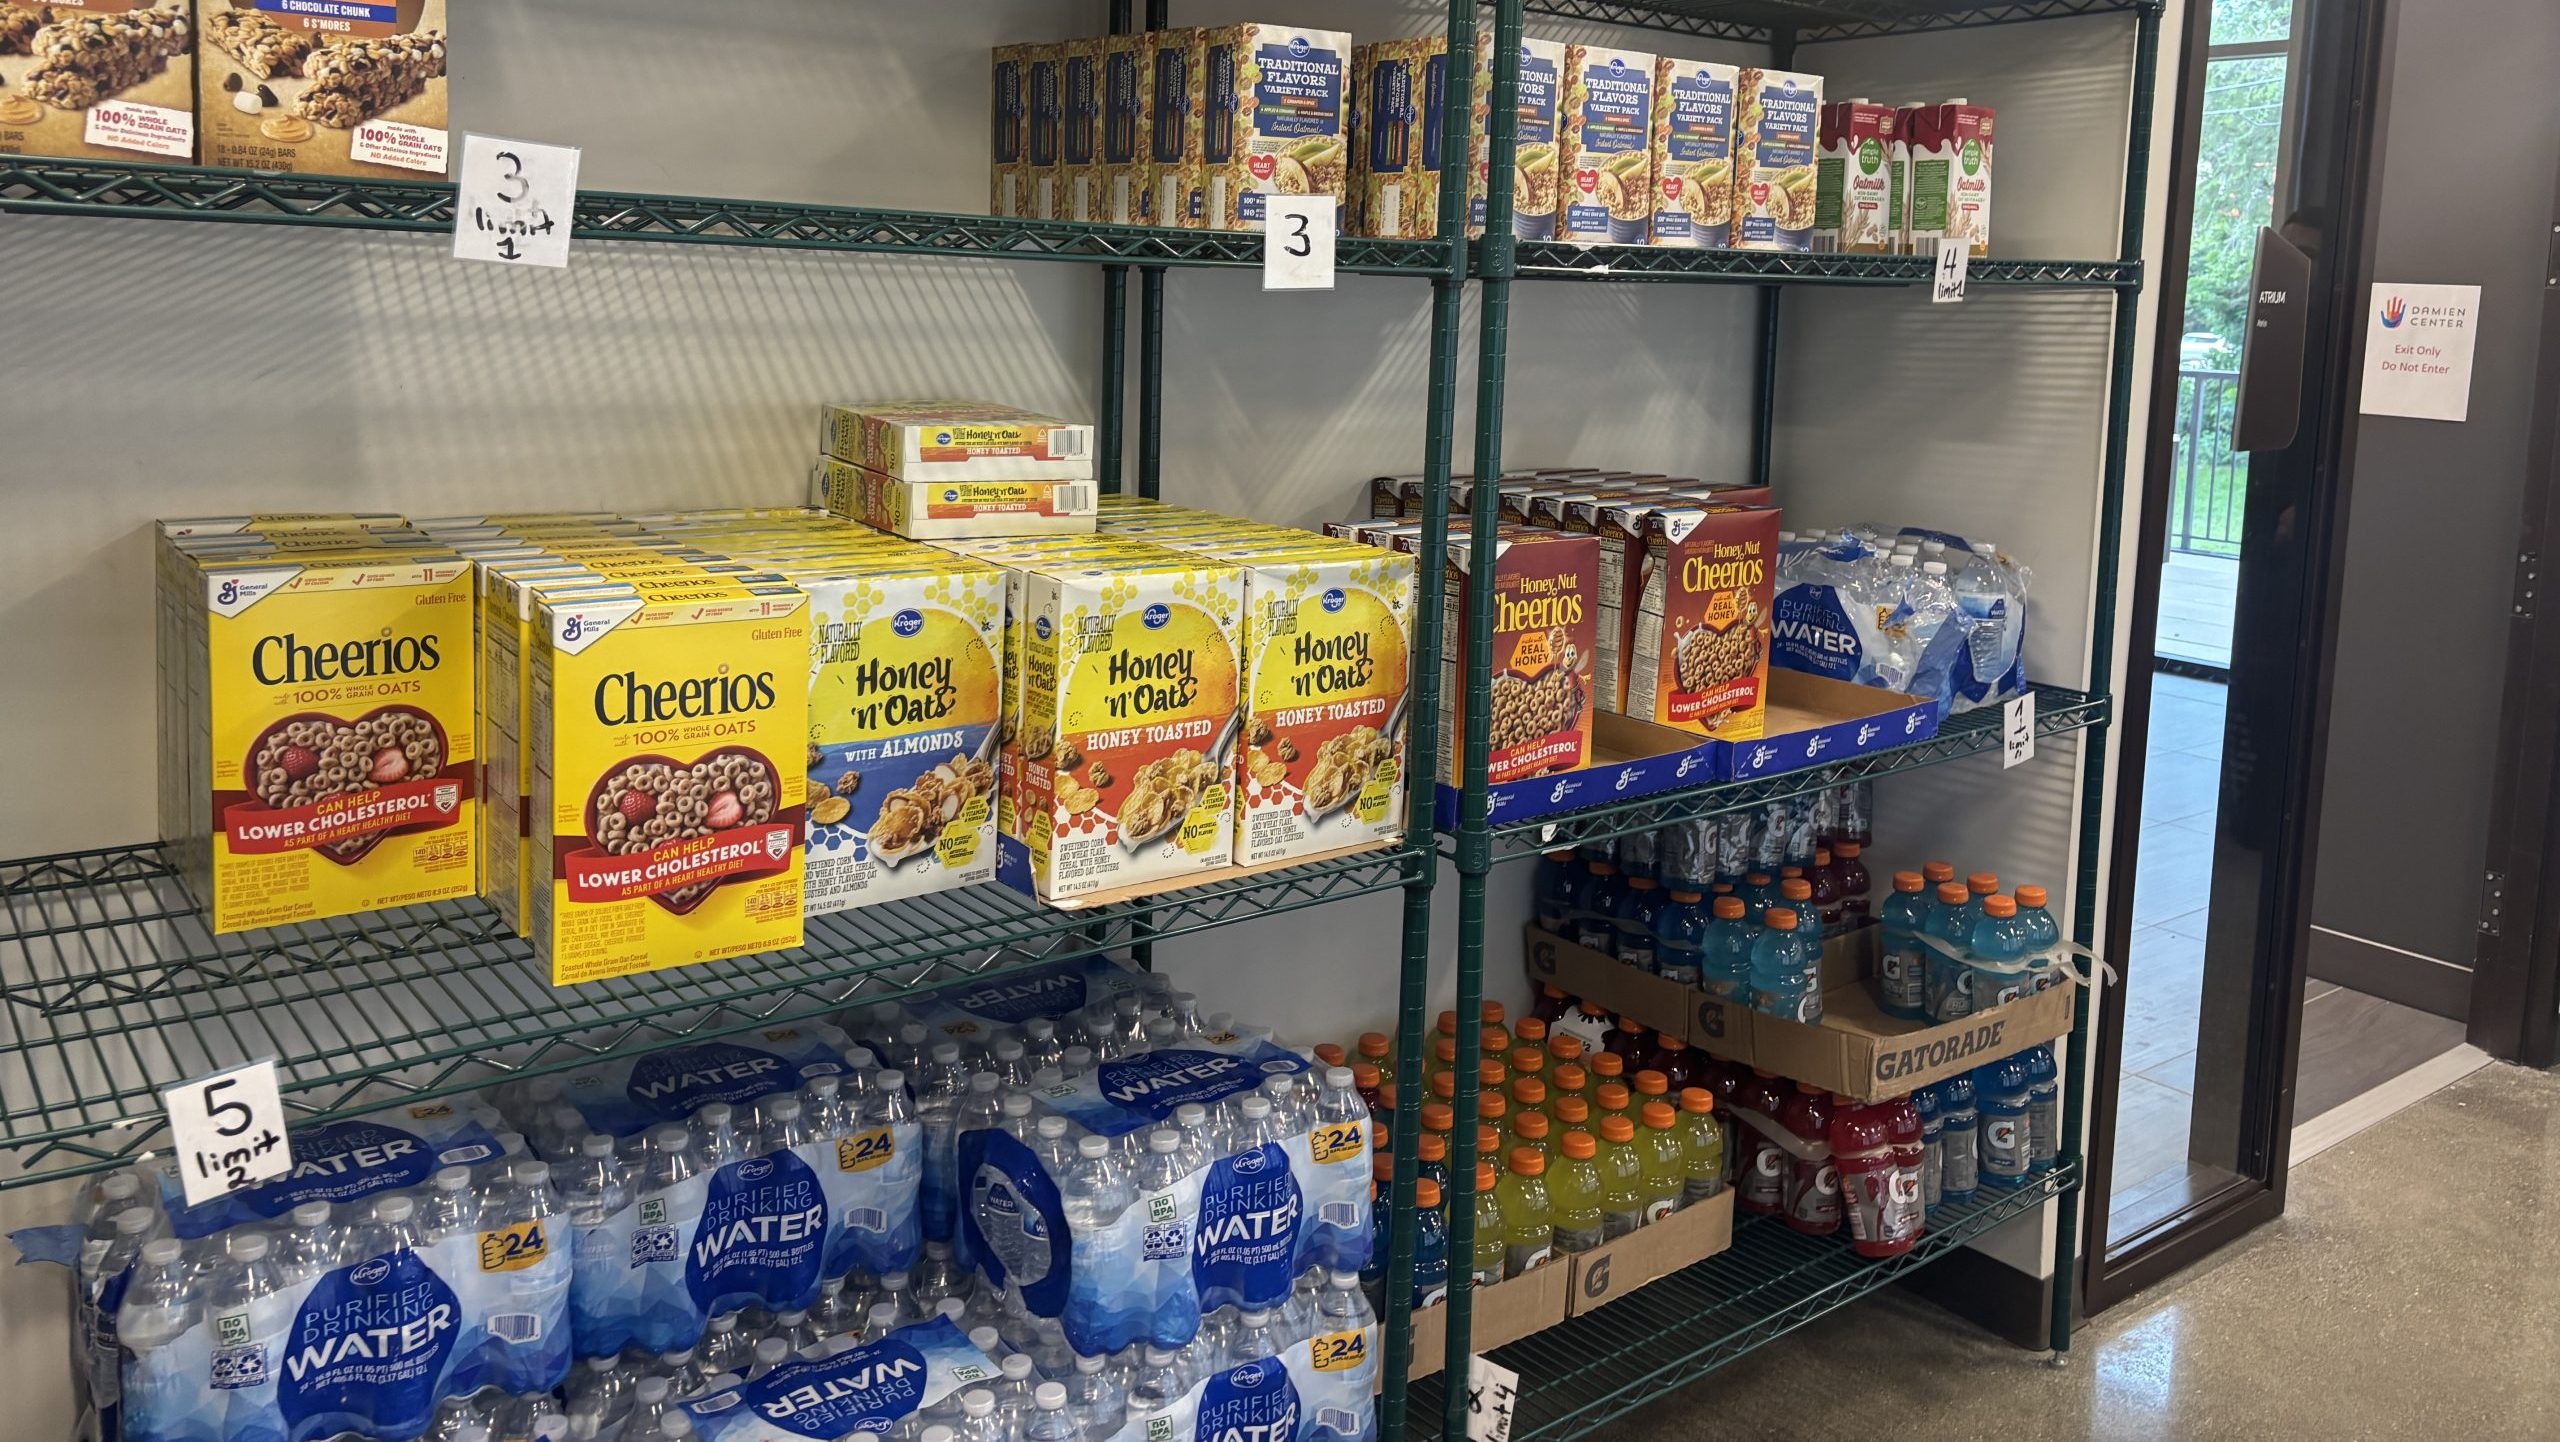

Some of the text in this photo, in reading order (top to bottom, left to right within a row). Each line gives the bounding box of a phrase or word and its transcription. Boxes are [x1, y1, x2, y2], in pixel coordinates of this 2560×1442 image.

[289, 1, 370, 18] CHOCOLATE CHUNK
[303, 18, 351, 31] 6 S'MORES
[1258, 58, 1339, 75] TRADITIONAL
[1267, 72, 1326, 86] FLAVORS
[1586, 78, 1648, 94] TRADITIONAL
[1264, 85, 1328, 97] VARIETY PACK
[1527, 97, 1546, 106] PACK
[1592, 92, 1638, 104] FLAVORS
[1673, 90, 1731, 104] TRADITIONAL
[1590, 104, 1639, 115] VARIETY PACK
[1679, 103, 1722, 114] FLAVORS
[1762, 99, 1815, 112] TRADITIONAL
[95, 109, 136, 127] 100%
[1677, 114, 1723, 124] VARIETY PACK
[1765, 123, 1790, 131] VARIETY
[1767, 111, 1807, 122] FLAVORS
[360, 128, 425, 145] 100% WHOLE
[398, 140, 442, 152] GRAIN OATS
[1861, 154, 1879, 164] truth
[1964, 155, 1978, 165] truth
[496, 152, 529, 203] 3
[1853, 175, 1885, 190] Oatmilk
[1957, 176, 1985, 191] Oatmilk
[1284, 214, 1311, 256] 3
[496, 237, 521, 259] 1
[1944, 247, 1956, 279] 4
[2412, 306, 2466, 317] DAMIEN
[2410, 318, 2464, 329] CENTER
[2395, 344, 2442, 358] Exit Only
[2382, 361, 2450, 374] Do Not Enter
[1714, 540, 1761, 560] Honey Nut
[638, 577, 716, 589] Cheerios
[1520, 573, 1577, 594] Honey Nut
[1683, 554, 1764, 593] Cheerios
[415, 593, 466, 606] Gluten Free
[647, 590, 728, 602] Cheerios
[1713, 601, 1733, 611] REAL
[1267, 599, 1299, 619] NATURALLY
[1708, 610, 1735, 621] HONEY
[752, 627, 802, 641] Gluten Free
[819, 622, 862, 644] NATURALLY
[1078, 614, 1117, 634] NATURALLY
[1268, 618, 1297, 637] FLAVORED
[820, 642, 860, 664] FLAVORED
[1078, 633, 1112, 653] FLAVORED
[1295, 631, 1370, 666] Honey
[1521, 642, 1545, 654] REAL
[252, 627, 440, 685] Cheerios
[1515, 654, 1550, 667] HONEY
[856, 657, 954, 696] Honey
[1109, 649, 1195, 685] Honey
[293, 688, 342, 704] 100%
[347, 680, 421, 699] GRAIN OATS
[594, 664, 776, 726] Cheerios
[1671, 701, 1700, 713] LOWER
[1702, 687, 1755, 707] CHOLESTEROL
[1276, 698, 1386, 728] HONEY TOASTED
[2014, 699, 2026, 734] 1
[633, 725, 710, 745] 100% WHOLE
[684, 720, 756, 739] GRAIN OATS
[1087, 720, 1212, 751] HONEY TOASTED
[845, 730, 964, 762] WITH ALMONDS
[1510, 739, 1546, 757] CAN HELP
[1511, 741, 1577, 766] CHOLESTEROL
[316, 791, 381, 816] CAN HELP
[1360, 797, 1372, 810] NO
[239, 795, 428, 840] LOWER CHOLESTEROL
[337, 813, 411, 838] HEART HEALTHY DIET
[1183, 826, 1198, 840] NO
[653, 838, 715, 862] CAN HELP
[939, 838, 953, 851] NO
[578, 841, 761, 888] LOWER CHOLESTEROL
[621, 860, 744, 897] AS PART OF A HEART HEALTHY DIET
[1881, 954, 1901, 979] G
[962, 974, 1080, 1007] WATER
[1699, 1002, 1725, 1037] G
[1875, 1020, 2005, 1082] GATORADE
[633, 1057, 781, 1098] WATER
[1108, 1058, 1238, 1102] WATER
[203, 1078, 252, 1137] 5
[857, 1133, 891, 1158] 24
[1328, 1131, 1361, 1150] 24
[1987, 1121, 2016, 1149] G
[196, 1130, 280, 1178] limit
[1756, 1149, 1782, 1178] G
[227, 1167, 256, 1189] 2
[708, 1180, 809, 1216] PURIFIED
[706, 1193, 812, 1232] DRINKING
[1153, 1206, 1173, 1216] BPA
[1197, 1193, 1298, 1257] WATER
[505, 1231, 545, 1256] 24
[695, 1204, 823, 1268] WATER
[1584, 1253, 1611, 1299] G
[305, 1282, 431, 1328] PURIFIED
[304, 1294, 434, 1345] DRINKING
[287, 1303, 451, 1382] WATER
[1330, 1334, 1364, 1358] 24
[762, 1357, 921, 1419] WATER
[793, 1376, 913, 1422] DRINKING
[803, 1386, 916, 1430] PURIFIED
